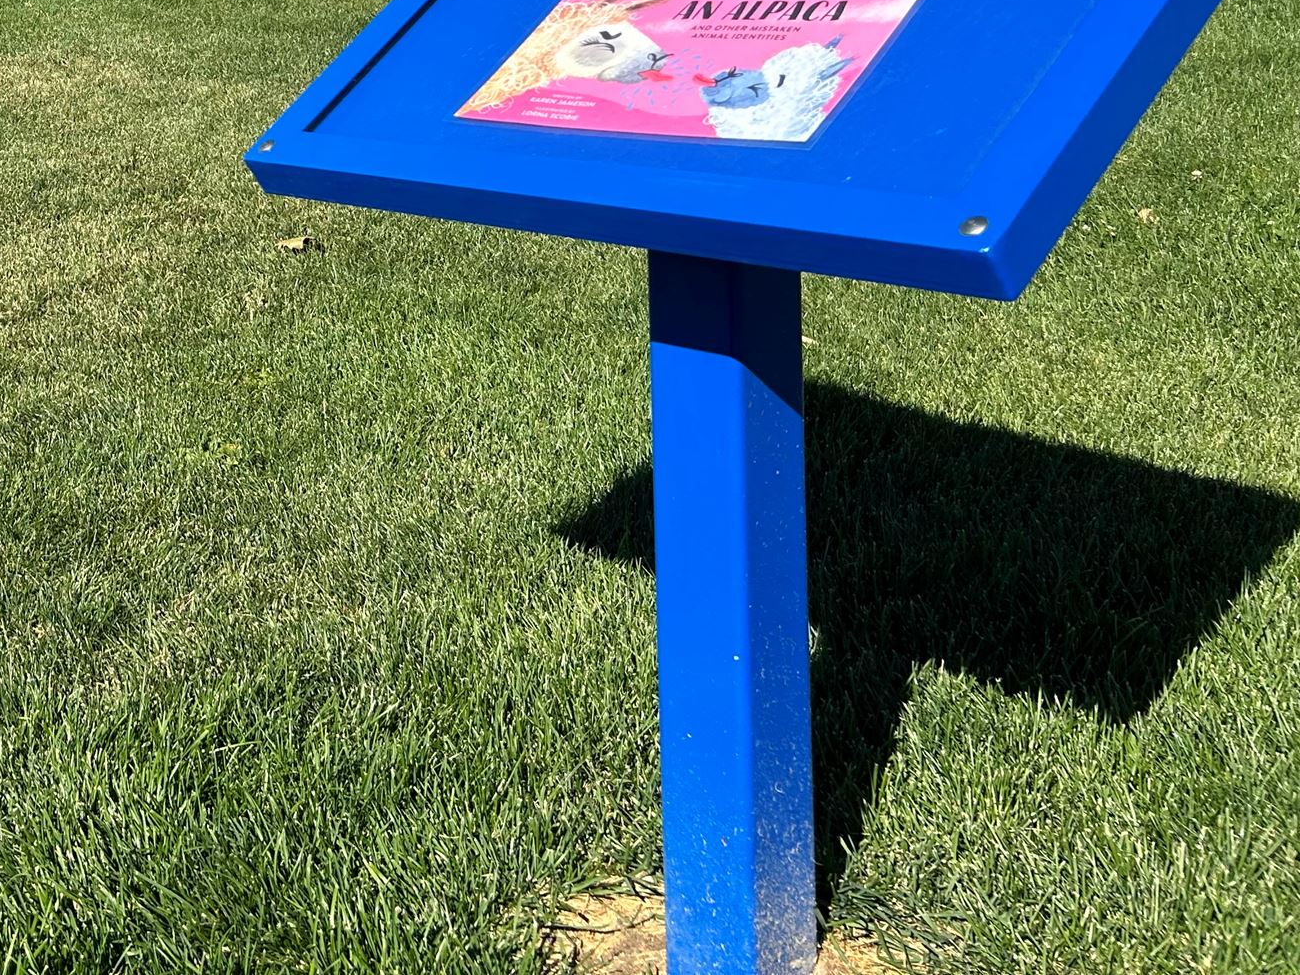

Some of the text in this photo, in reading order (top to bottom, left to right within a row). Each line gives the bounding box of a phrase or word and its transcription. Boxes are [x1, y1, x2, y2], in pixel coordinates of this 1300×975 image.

[672, 0, 848, 21] AN ALPACA
[731, 33, 787, 41] IDENTITIES
